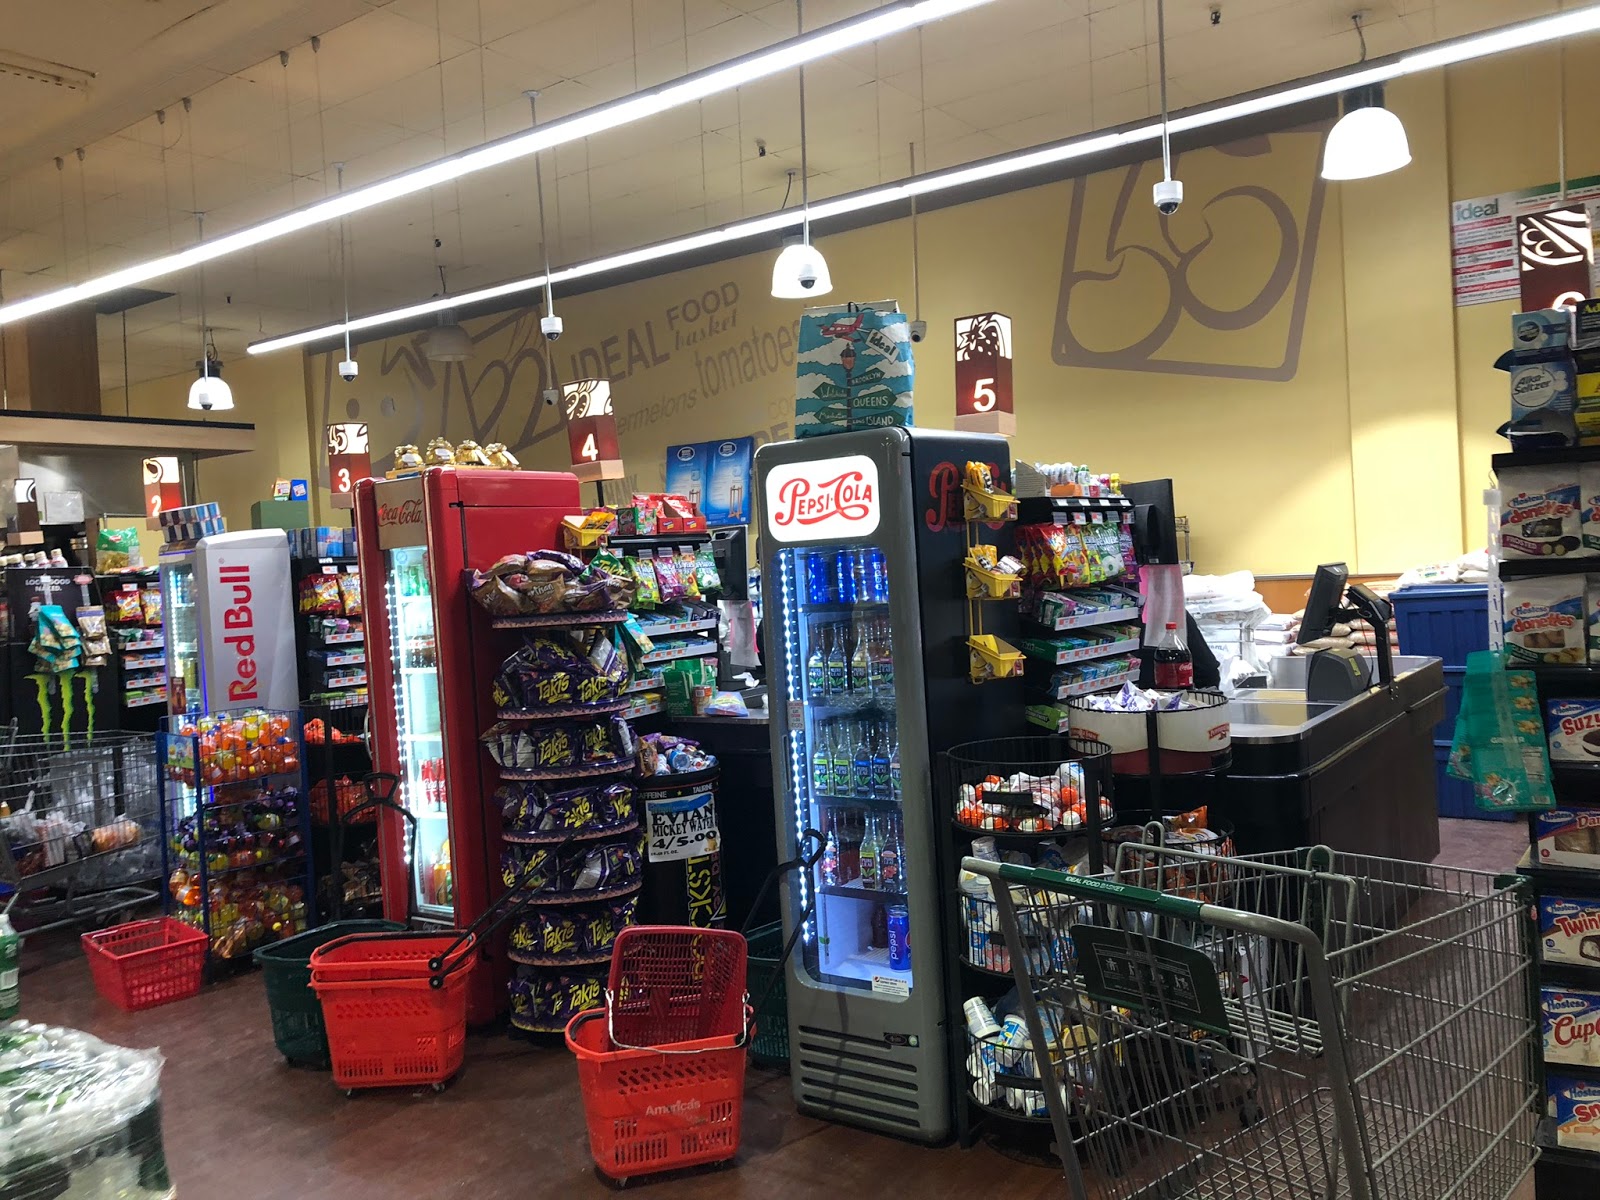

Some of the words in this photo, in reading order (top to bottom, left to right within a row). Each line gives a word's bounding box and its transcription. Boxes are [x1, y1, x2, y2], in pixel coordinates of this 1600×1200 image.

[1456, 198, 1499, 221] ideal
[666, 281, 741, 330] FOOD
[674, 308, 738, 351] basket
[571, 320, 671, 388] IDEAL
[868, 331, 898, 357] ideal
[852, 371, 882, 385] BROOKLYN
[1513, 379, 1552, 395] Seltzer
[1516, 373, 1545, 387] Alka-
[852, 395, 889, 408] QUEENS
[973, 377, 997, 412] 5
[617, 388, 697, 437] ermelons
[865, 415, 894, 426] ISLAND
[582, 433, 598, 461] 4
[338, 467, 350, 493] 3
[151, 494, 162, 517] 2
[219, 565, 254, 629] Bull
[1513, 613, 1575, 633] donettes
[224, 634, 258, 702] Red
[536, 672, 571, 702] Takis
[539, 733, 569, 766] Takis
[637, 790, 667, 799] AFFEINE
[652, 804, 713, 826] EVIAN
[652, 821, 688, 838] MICKEY
[652, 830, 718, 850] 4/5.00
[1065, 876, 1082, 886] IDEAL
[1082, 879, 1101, 889] FOOD
[1100, 882, 1126, 893] BASKET
[543, 922, 576, 953] Takis
[890, 930, 899, 960] pepsi
[569, 979, 601, 1011] Takis
[1547, 998, 1586, 1011] Hostess
